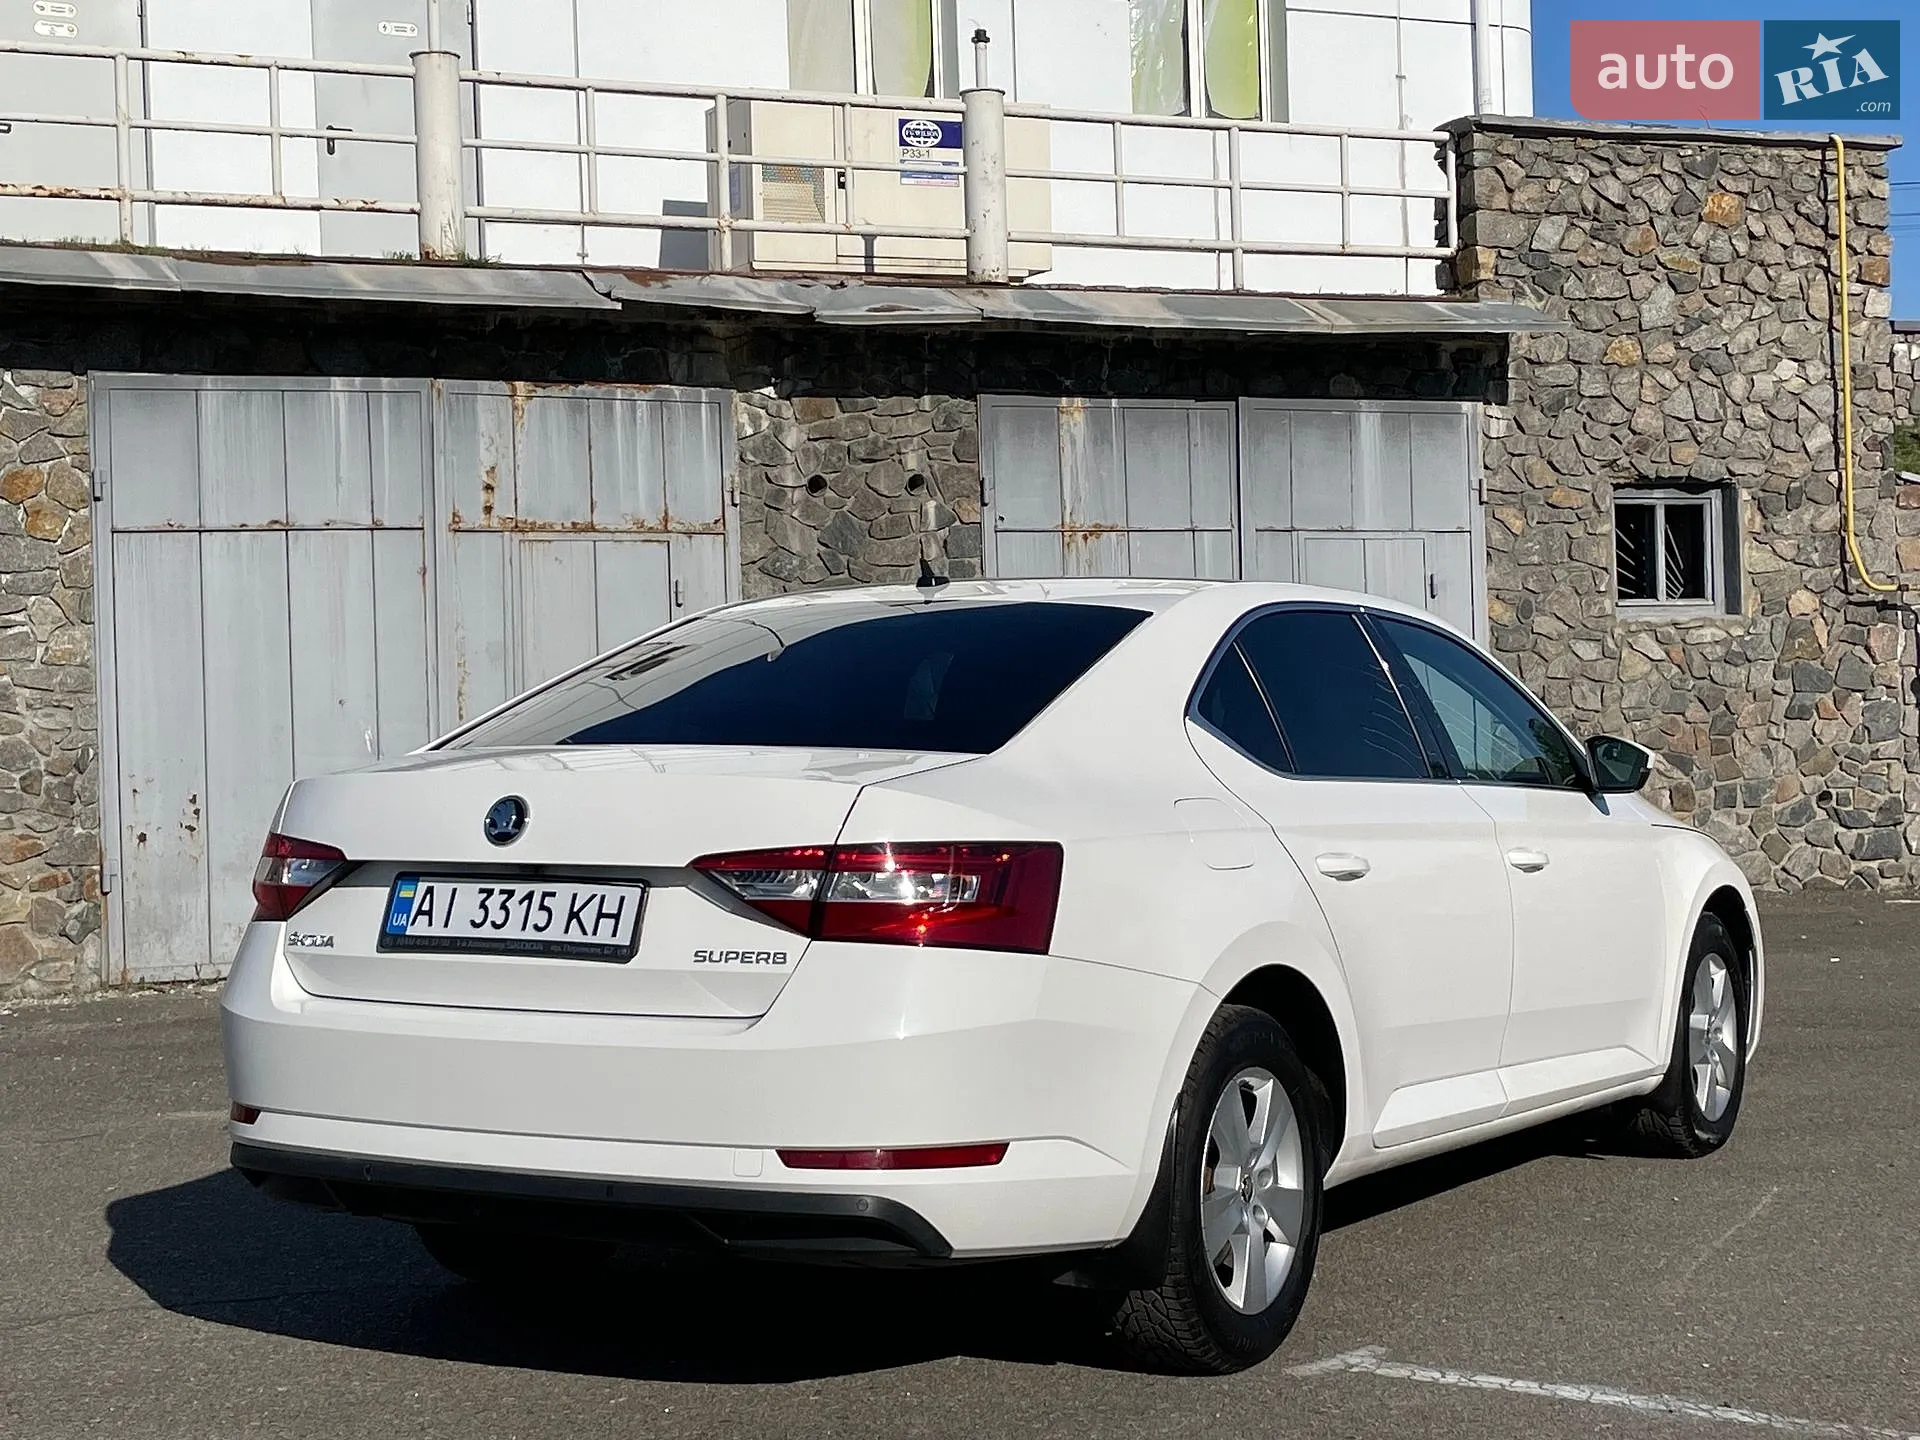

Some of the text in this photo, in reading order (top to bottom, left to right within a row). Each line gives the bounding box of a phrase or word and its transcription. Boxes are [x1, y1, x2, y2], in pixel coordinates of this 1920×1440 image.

[902, 149, 930, 158] P33-1
[410, 885, 627, 938] AI 3315 KH
[392, 913, 407, 927] UA
[693, 950, 788, 965] SUPERB
